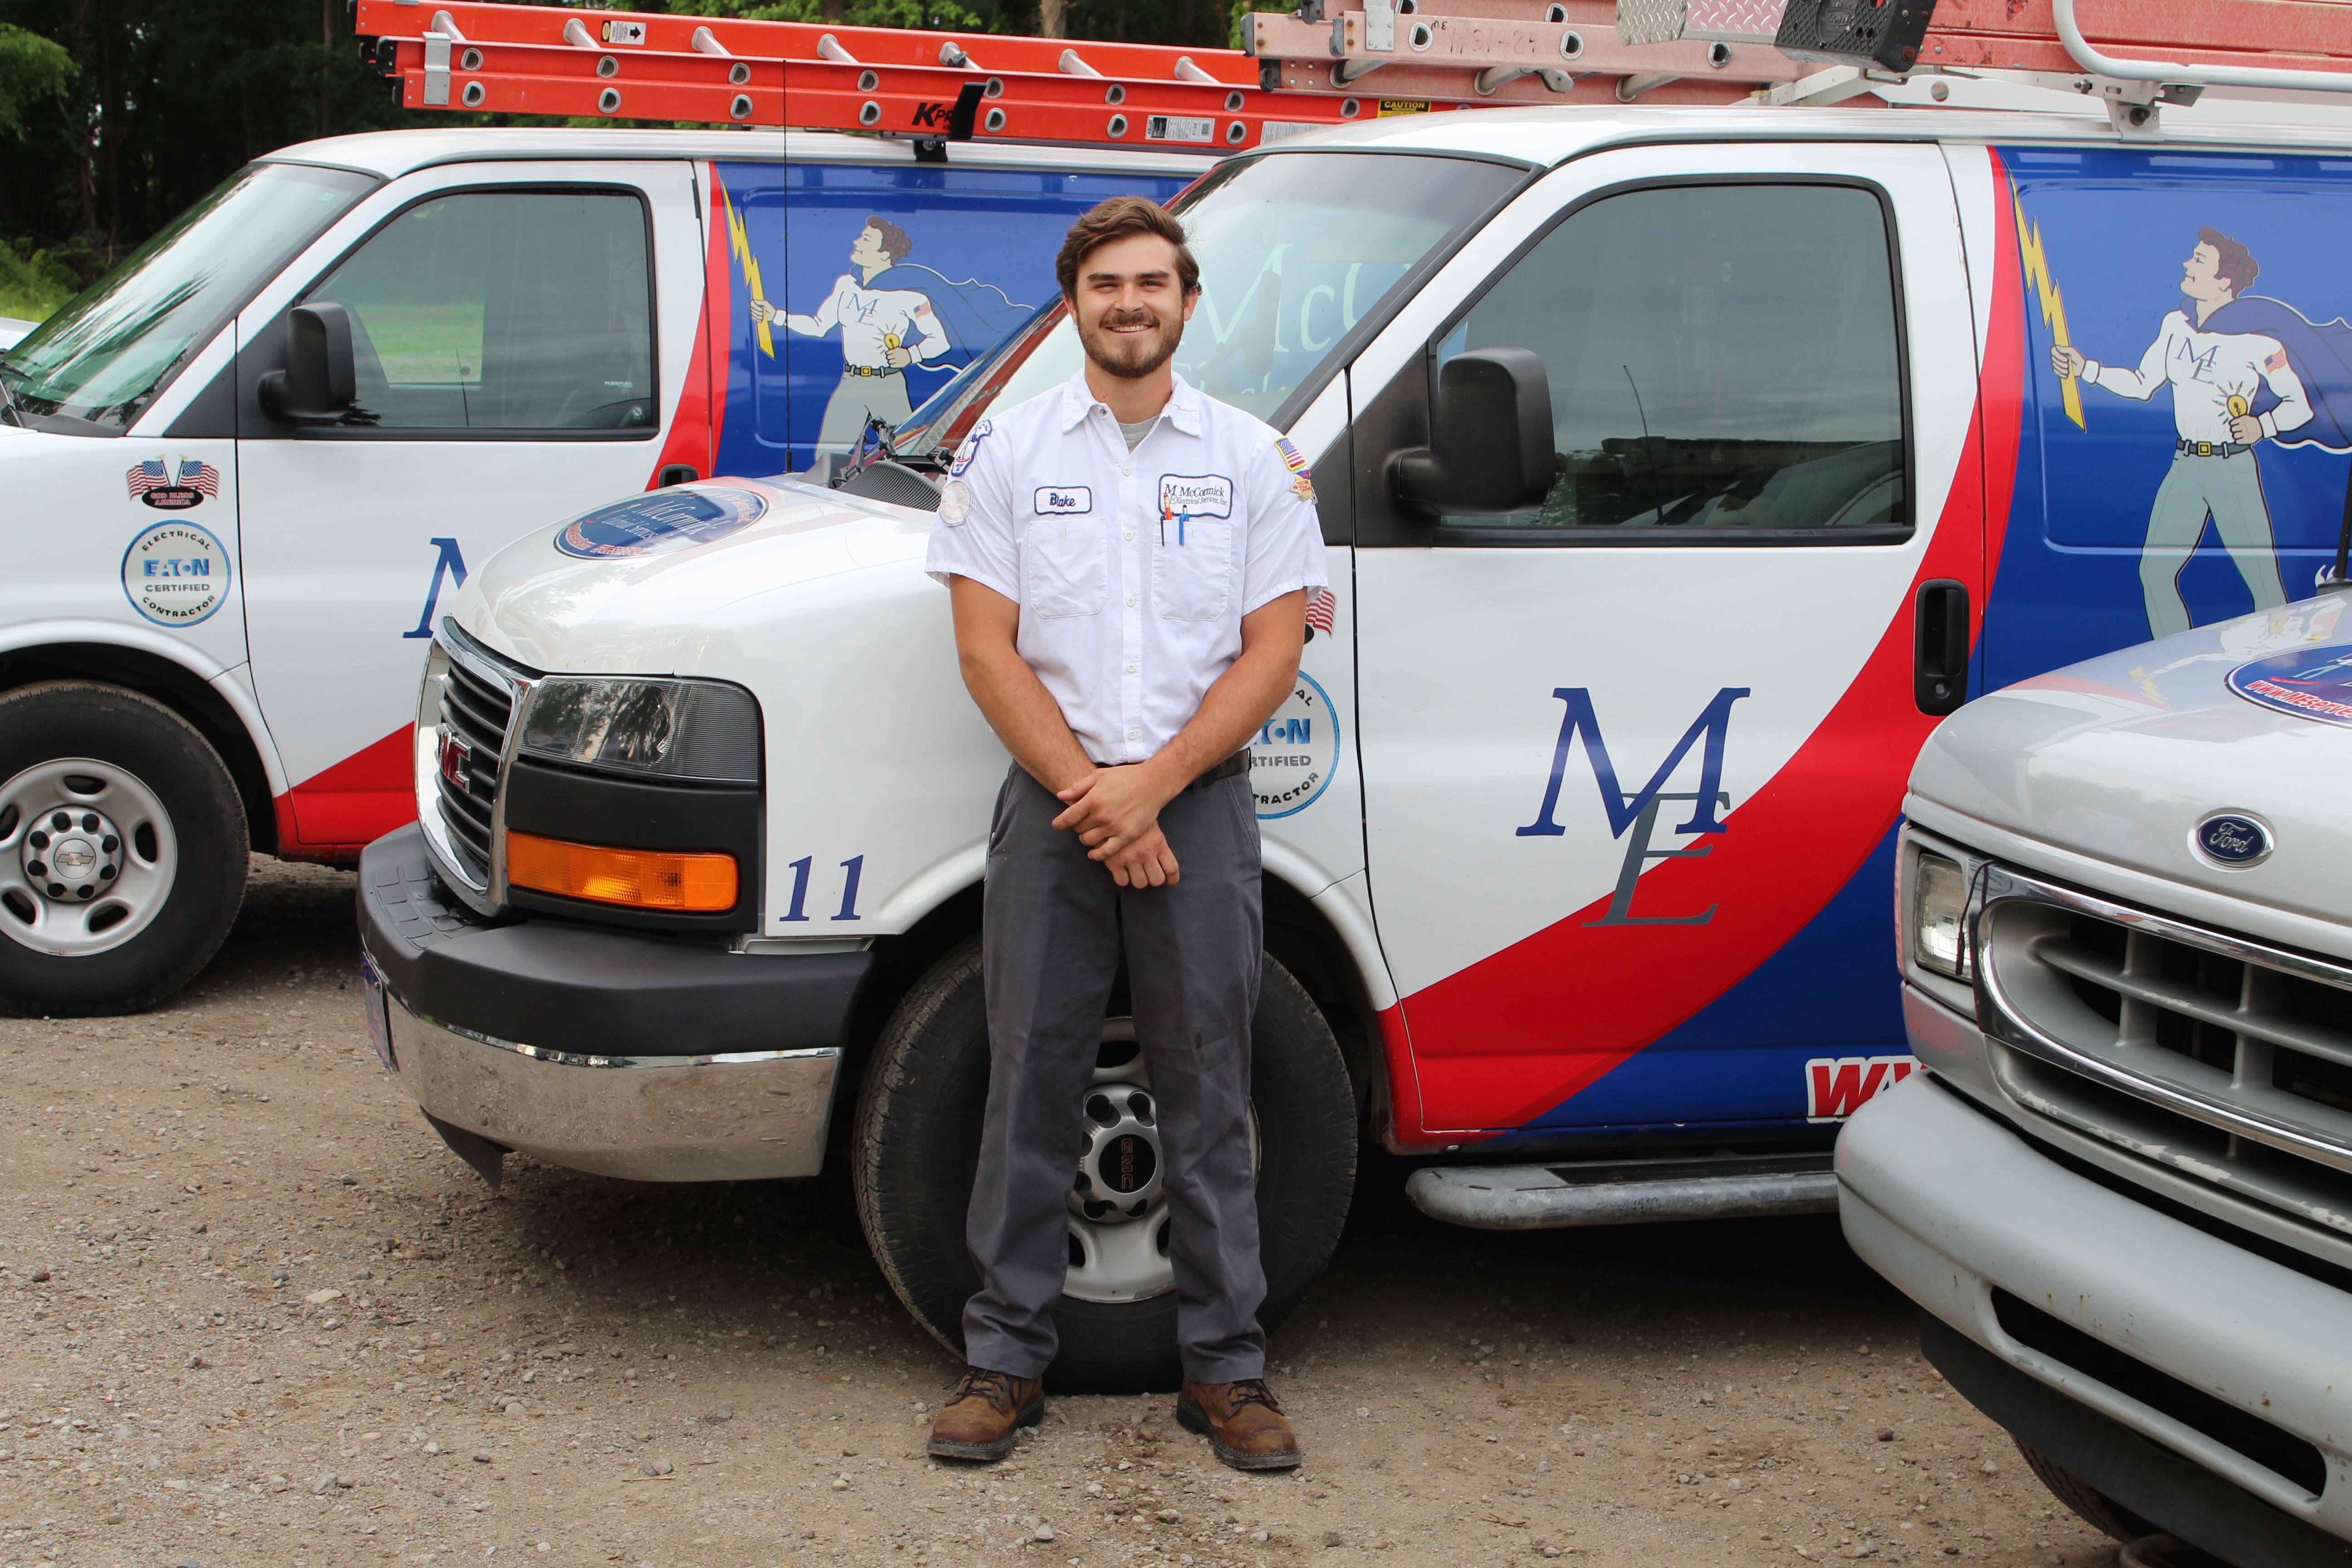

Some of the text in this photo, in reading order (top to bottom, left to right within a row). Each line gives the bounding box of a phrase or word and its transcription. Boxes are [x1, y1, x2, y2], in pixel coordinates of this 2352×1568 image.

[1050, 493, 1076, 507] Blake
[1179, 486, 1225, 497] McCormick
[1220, 498, 1228, 506] Inc.
[142, 530, 211, 551] ELECTRICAL
[143, 559, 209, 577] EATON
[145, 583, 210, 592] CERTIFIED
[142, 594, 216, 617] CONTRACTOR
[2244, 679, 2352, 718] www.MEserve
[2209, 822, 2254, 853] Ford
[779, 854, 864, 921] 11
[1122, 1138, 1133, 1189] GMC
